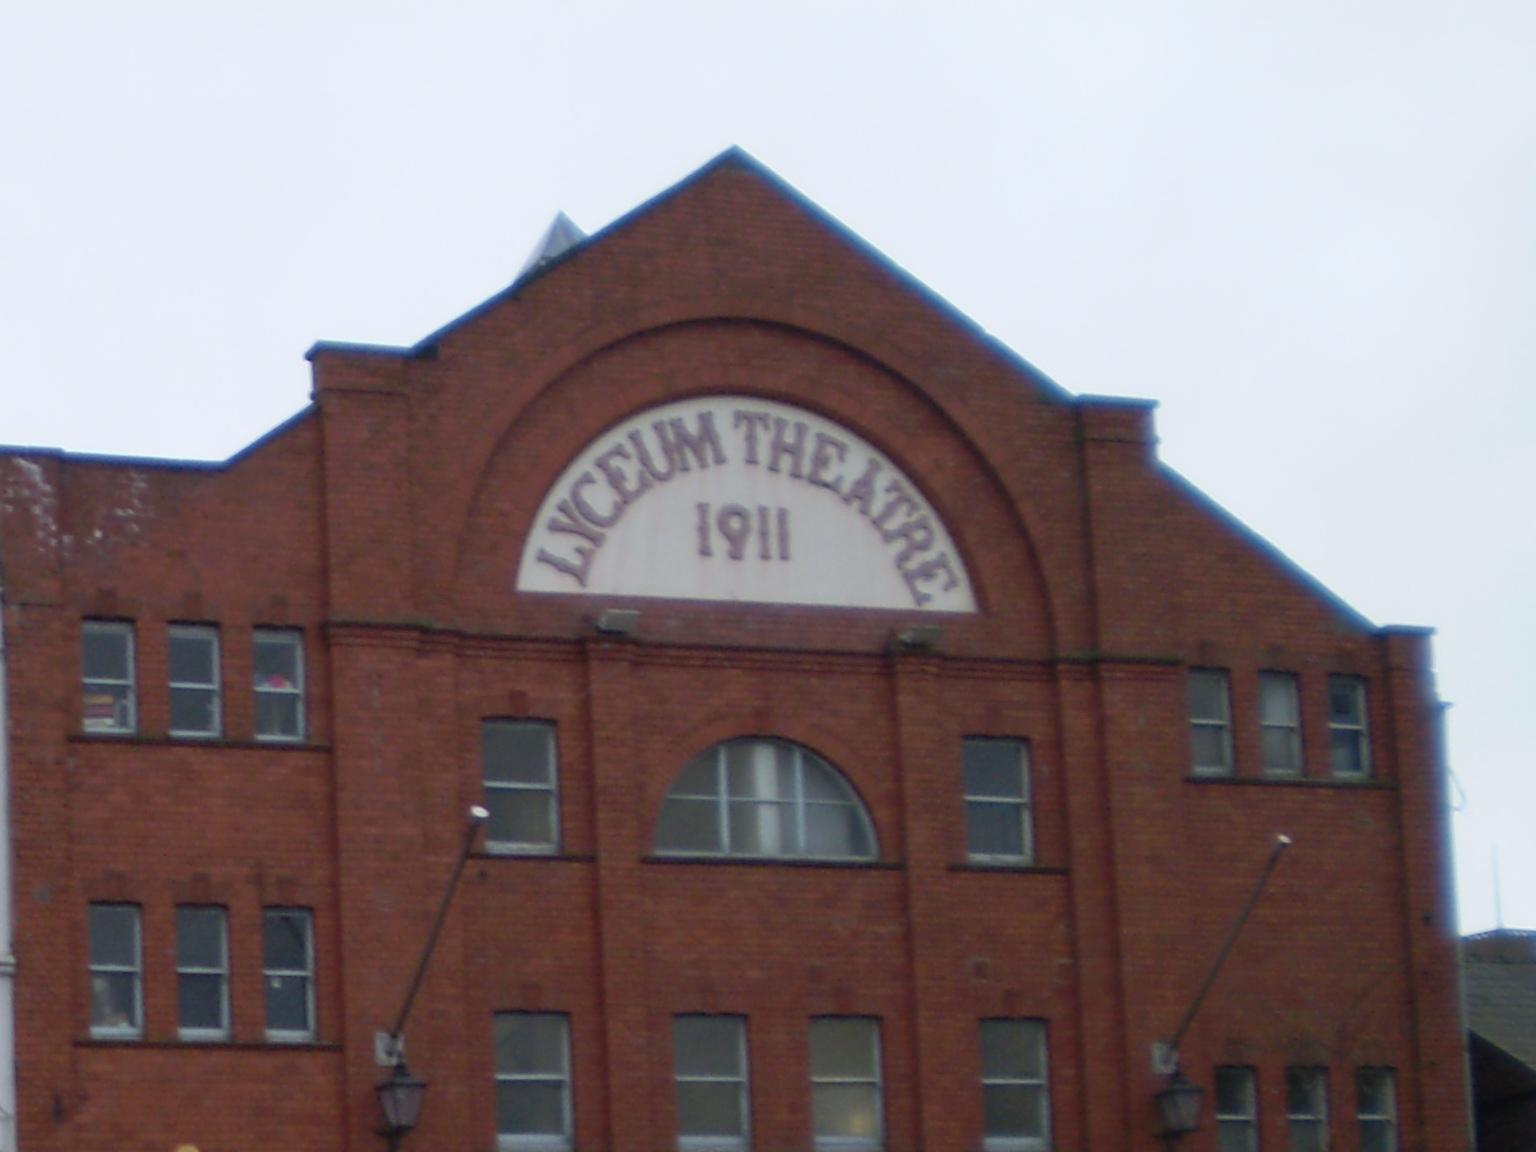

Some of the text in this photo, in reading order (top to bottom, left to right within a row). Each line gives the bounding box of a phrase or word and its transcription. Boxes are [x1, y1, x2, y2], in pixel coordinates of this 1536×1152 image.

[536, 409, 960, 608] LYCEUM THEATRE
[697, 502, 790, 561] 1911
